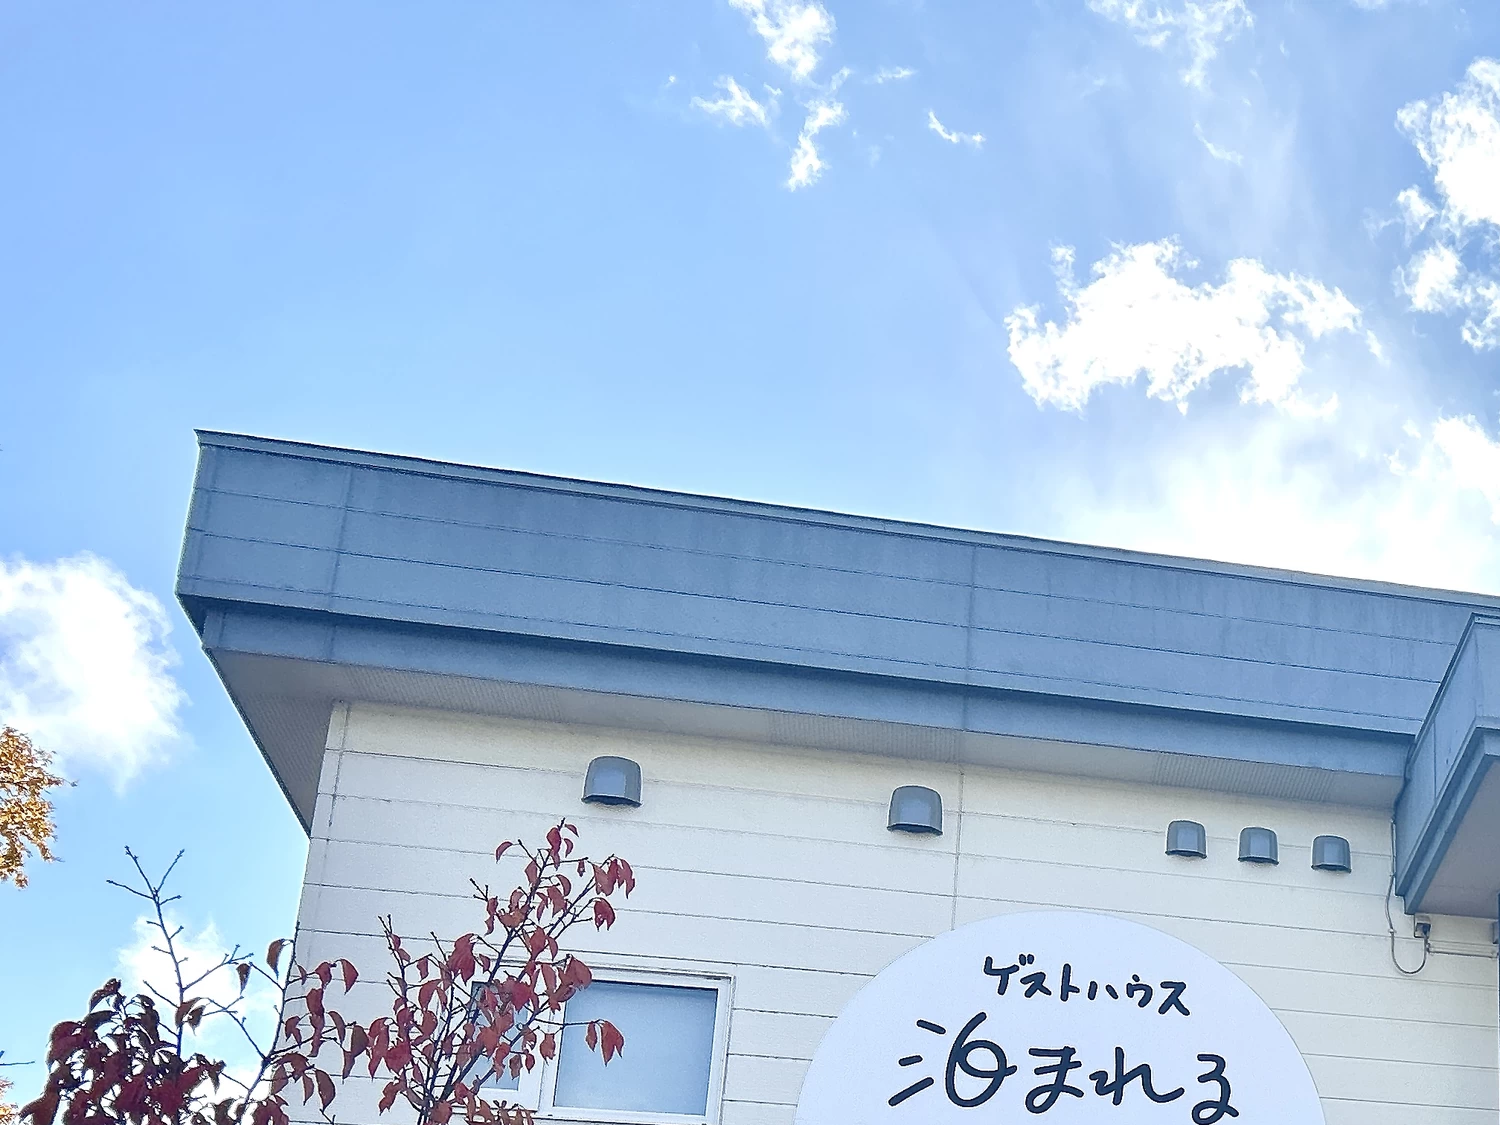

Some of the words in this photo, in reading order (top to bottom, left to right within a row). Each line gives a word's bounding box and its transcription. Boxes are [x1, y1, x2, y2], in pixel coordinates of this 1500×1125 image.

[984, 953, 1191, 1017] ゲストハウス
[888, 1011, 1239, 1125] 泊まれる
